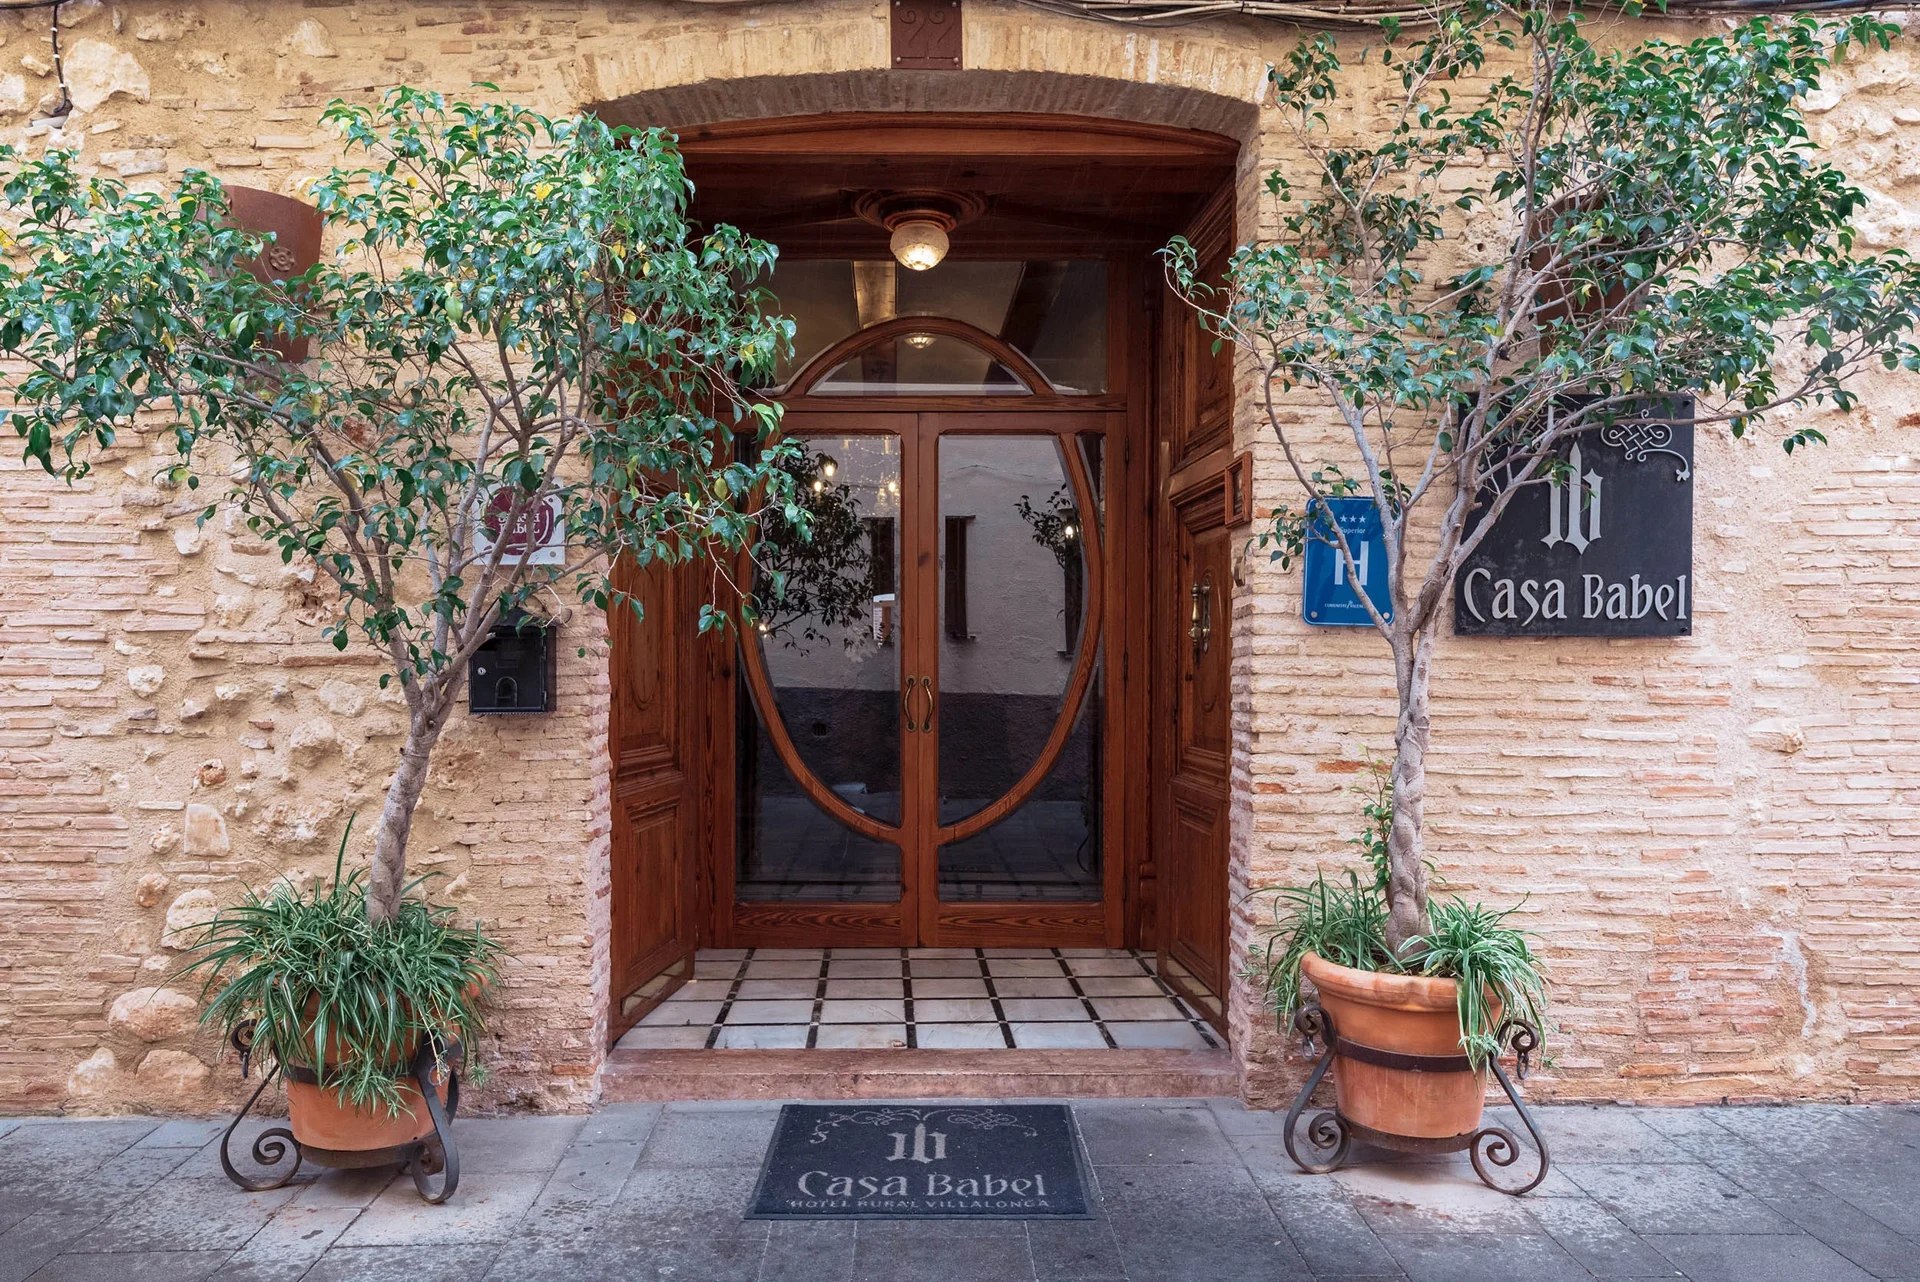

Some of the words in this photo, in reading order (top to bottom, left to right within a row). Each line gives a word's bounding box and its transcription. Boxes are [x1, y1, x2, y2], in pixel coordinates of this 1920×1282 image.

[1330, 541, 1369, 586] H
[1463, 567, 1567, 626] Casa
[1581, 573, 1687, 621] Babel
[798, 1170, 908, 1200] Casa
[926, 1173, 1046, 1197] Babel
[790, 1200, 850, 1208] HOTEL
[858, 1200, 919, 1208] RURAL
[925, 1200, 1049, 1208] VILLALONGA
